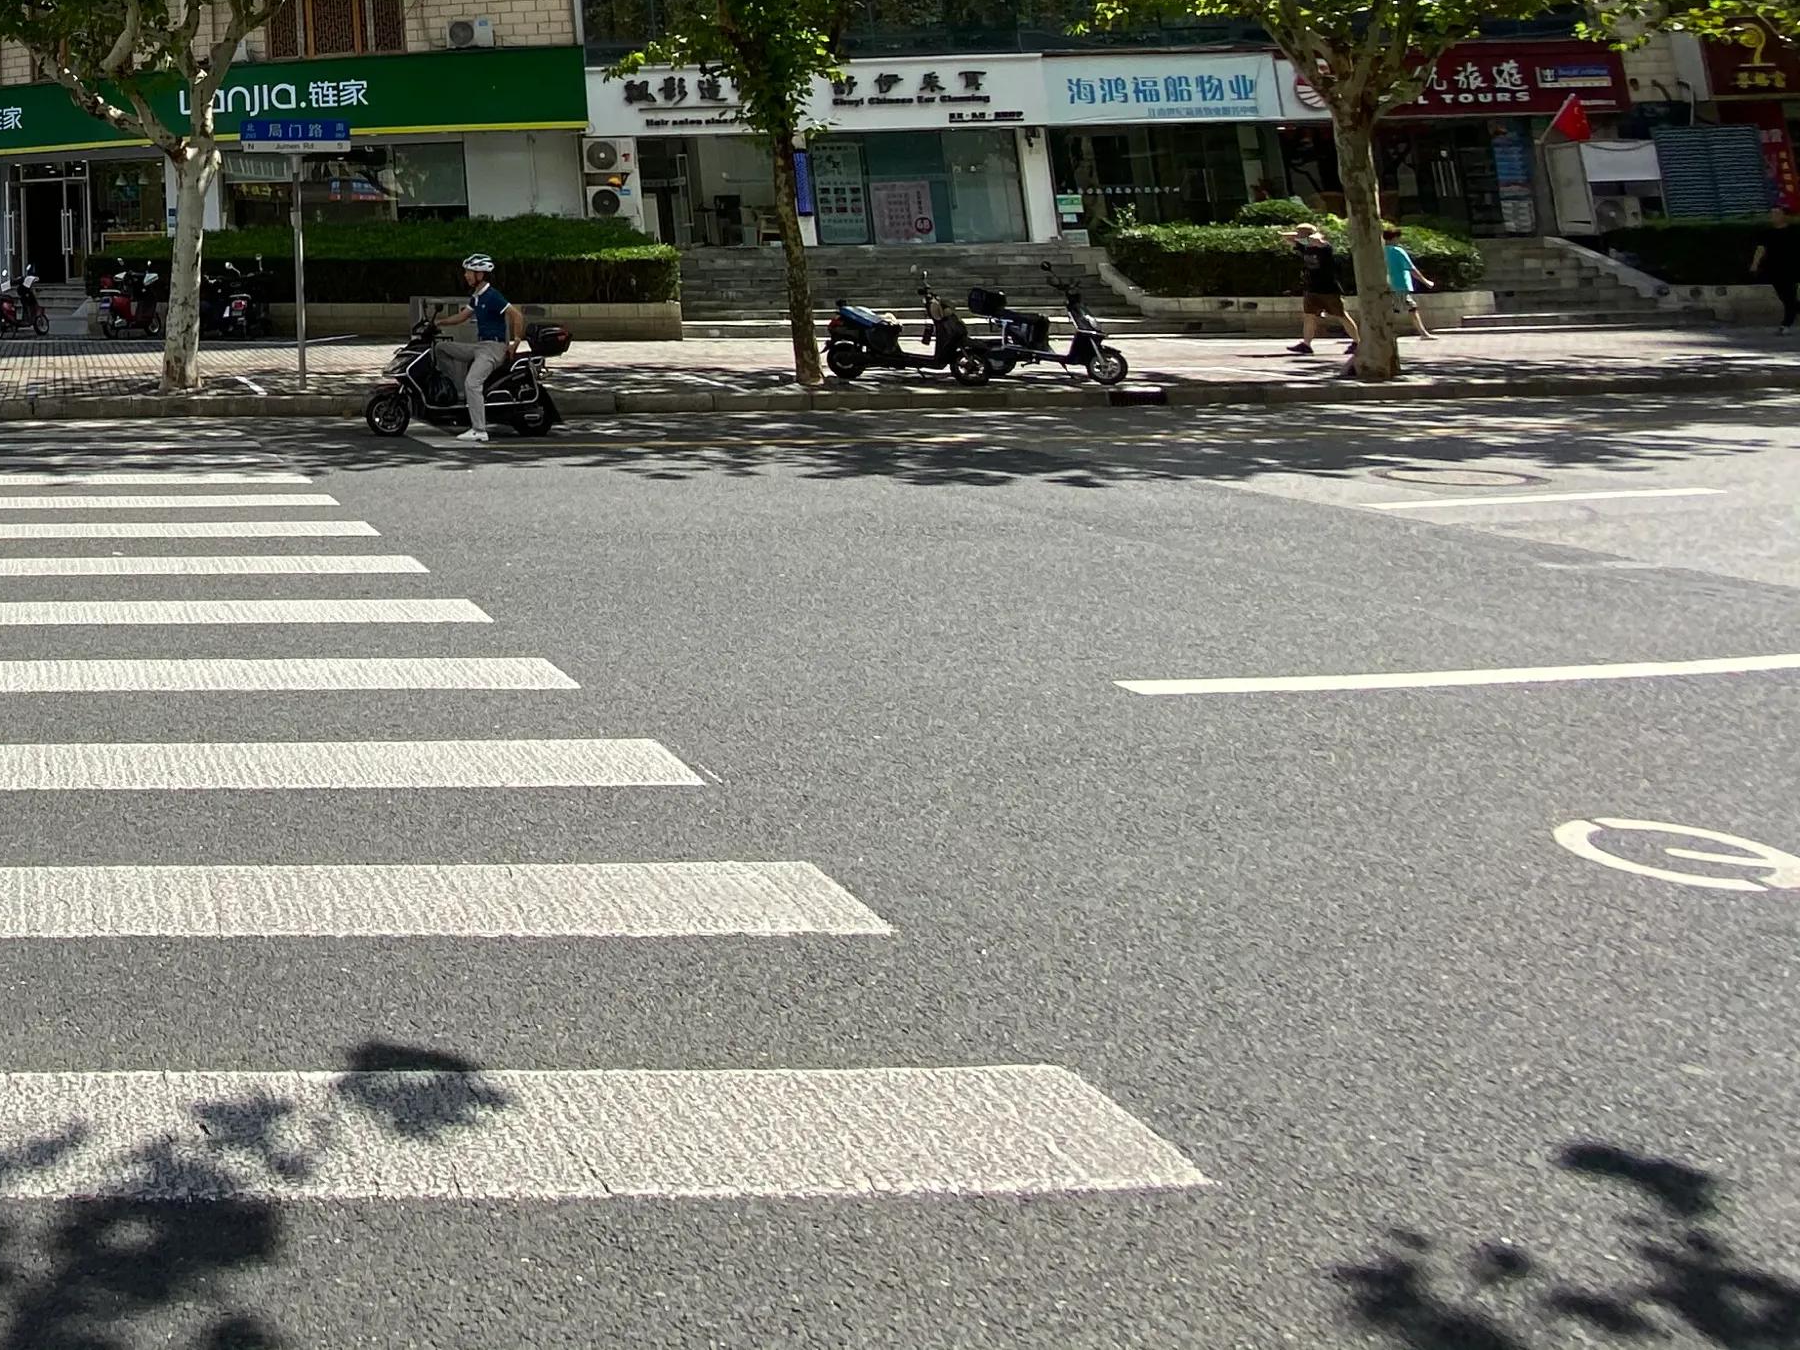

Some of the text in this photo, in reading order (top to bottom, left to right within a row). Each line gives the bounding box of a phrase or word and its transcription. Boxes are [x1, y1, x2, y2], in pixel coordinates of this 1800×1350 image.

[308, 79, 369, 108] 链家
[624, 76, 741, 106] 飘影造
[1067, 75, 1258, 105] 海鸿福船物业
[1441, 91, 1530, 104] TOURS
[268, 123, 323, 138] 局门路
